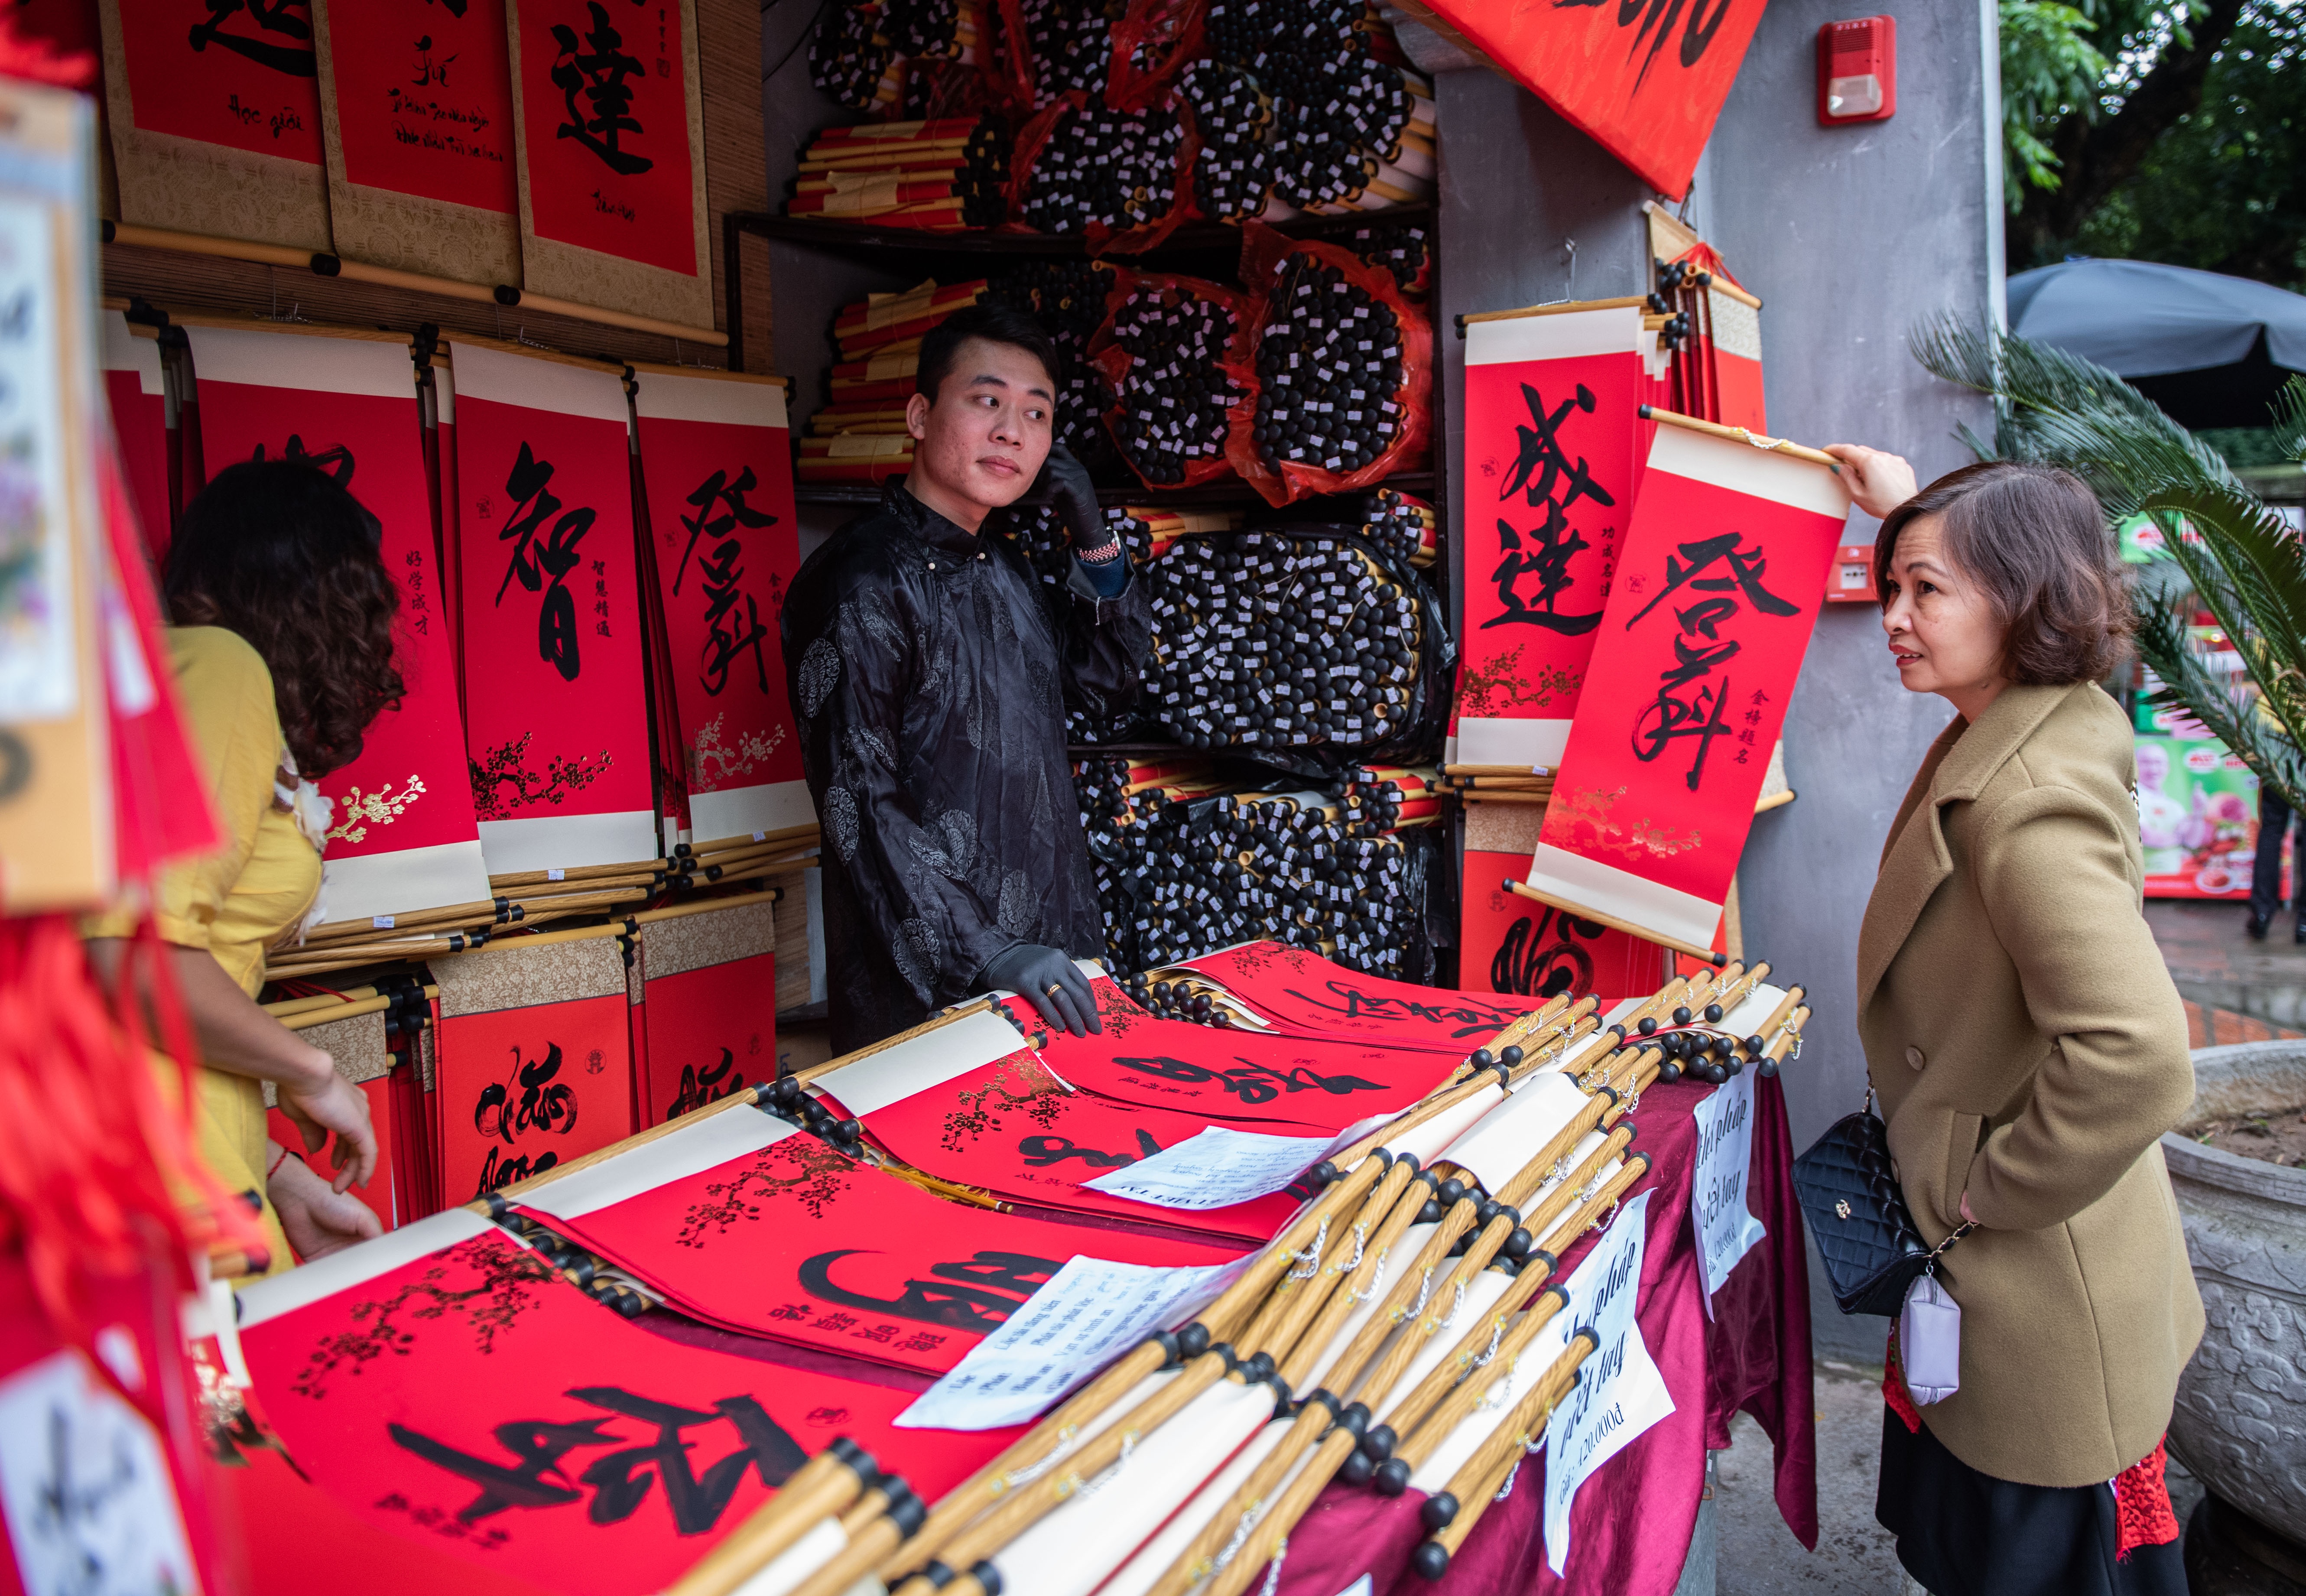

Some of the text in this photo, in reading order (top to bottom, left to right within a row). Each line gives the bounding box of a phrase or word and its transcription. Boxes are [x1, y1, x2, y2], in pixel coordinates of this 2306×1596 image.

[228, 94, 305, 139] Học giỏi
[495, 440, 597, 682] 智
[1732, 688, 1770, 765] 金榜題名
[1722, 1170, 1741, 1208] tay
[1593, 1237, 1637, 1328] pháp
[1596, 1330, 1629, 1394] tay
[1578, 1402, 1624, 1467] 120.000đ
